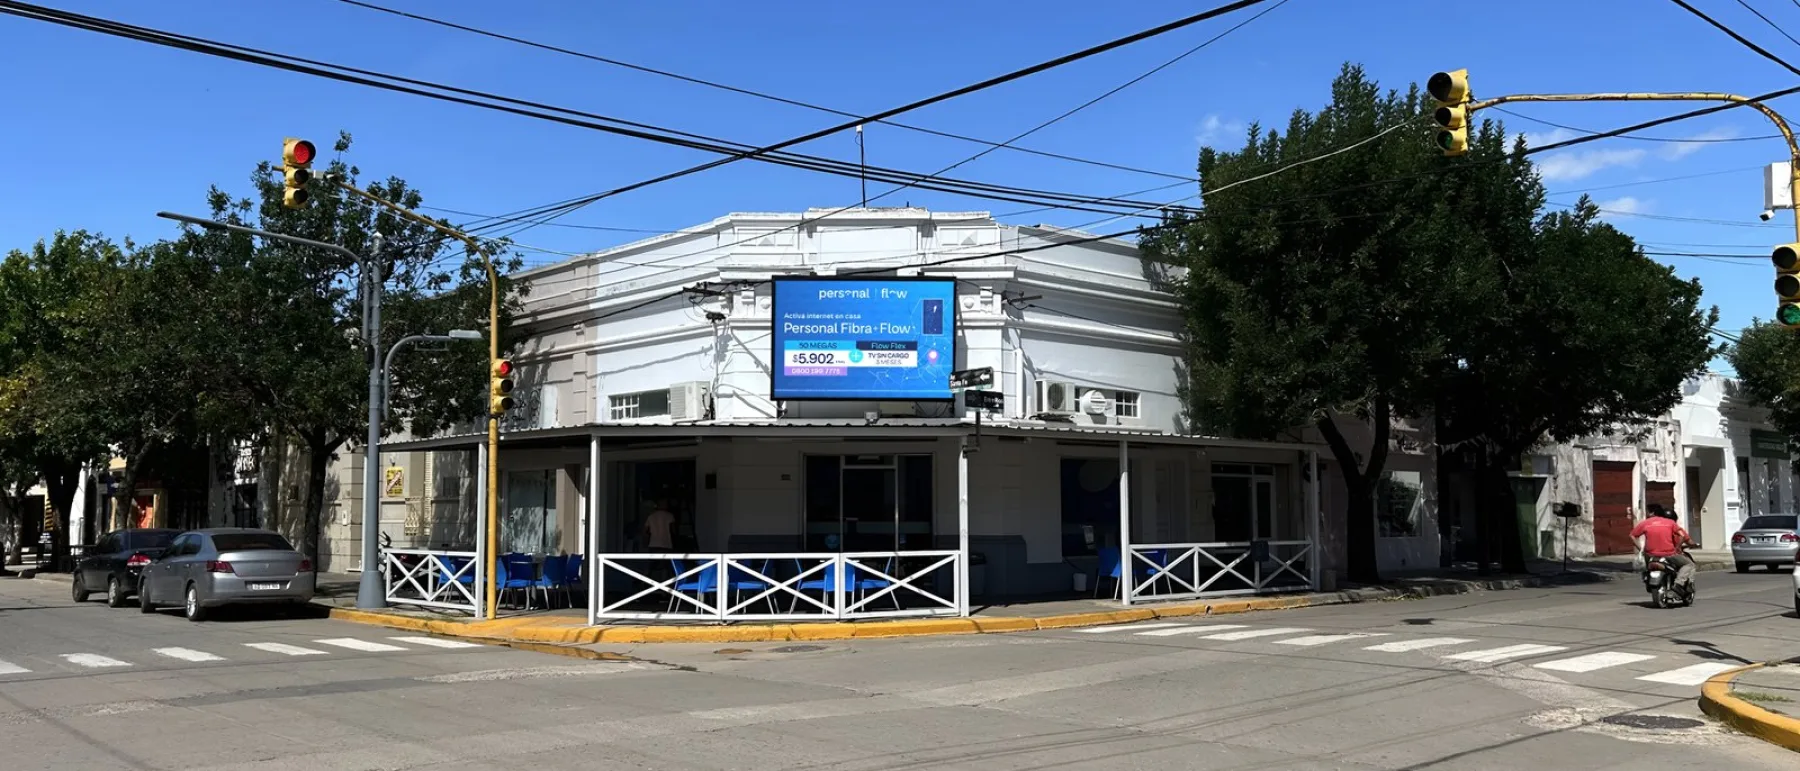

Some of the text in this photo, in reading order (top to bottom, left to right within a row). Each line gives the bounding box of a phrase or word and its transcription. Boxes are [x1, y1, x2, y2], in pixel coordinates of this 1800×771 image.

[818, 288, 870, 300] personal
[784, 322, 838, 334] Personal
[792, 353, 835, 364] $5.902
